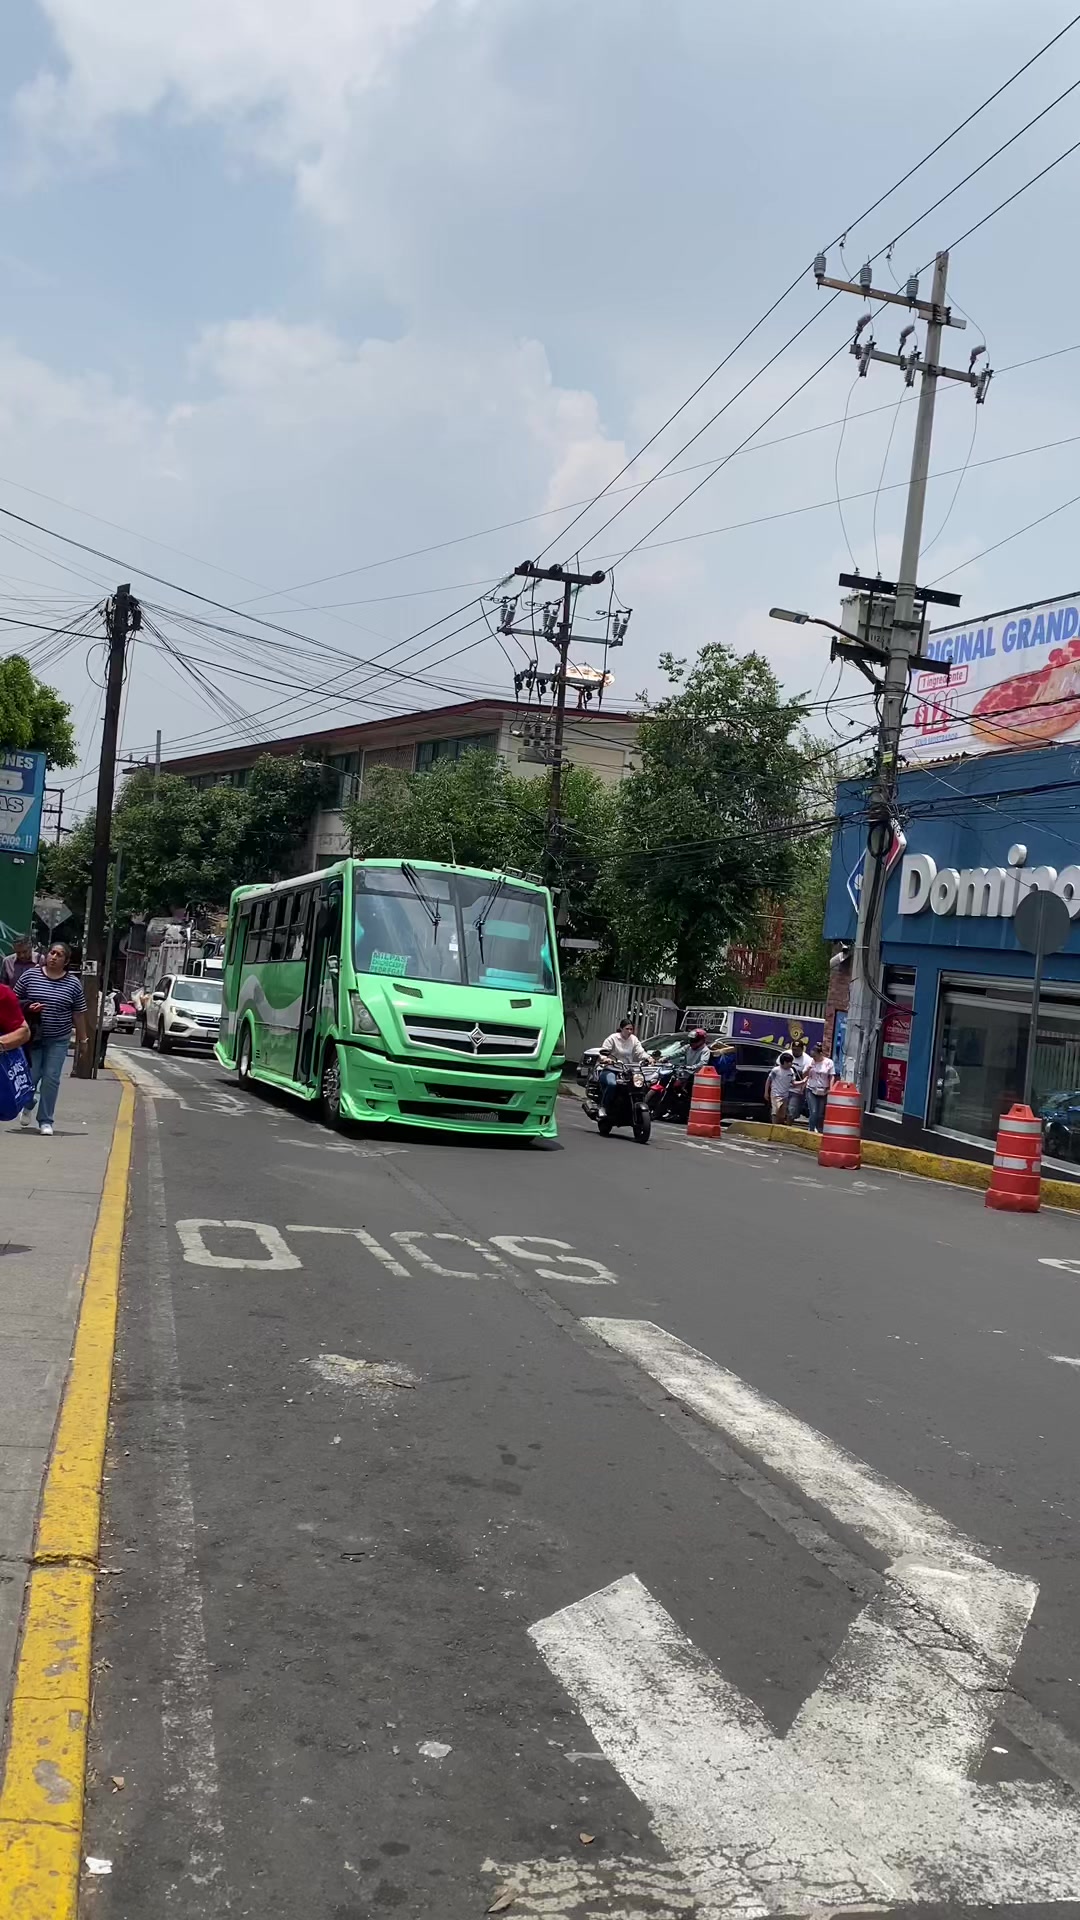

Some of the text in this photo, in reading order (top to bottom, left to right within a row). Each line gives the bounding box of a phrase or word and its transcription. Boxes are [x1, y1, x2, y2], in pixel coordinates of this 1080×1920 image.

[927, 606, 1080, 664] RIGINAL GRAND
[927, 671, 963, 688] ingredente
